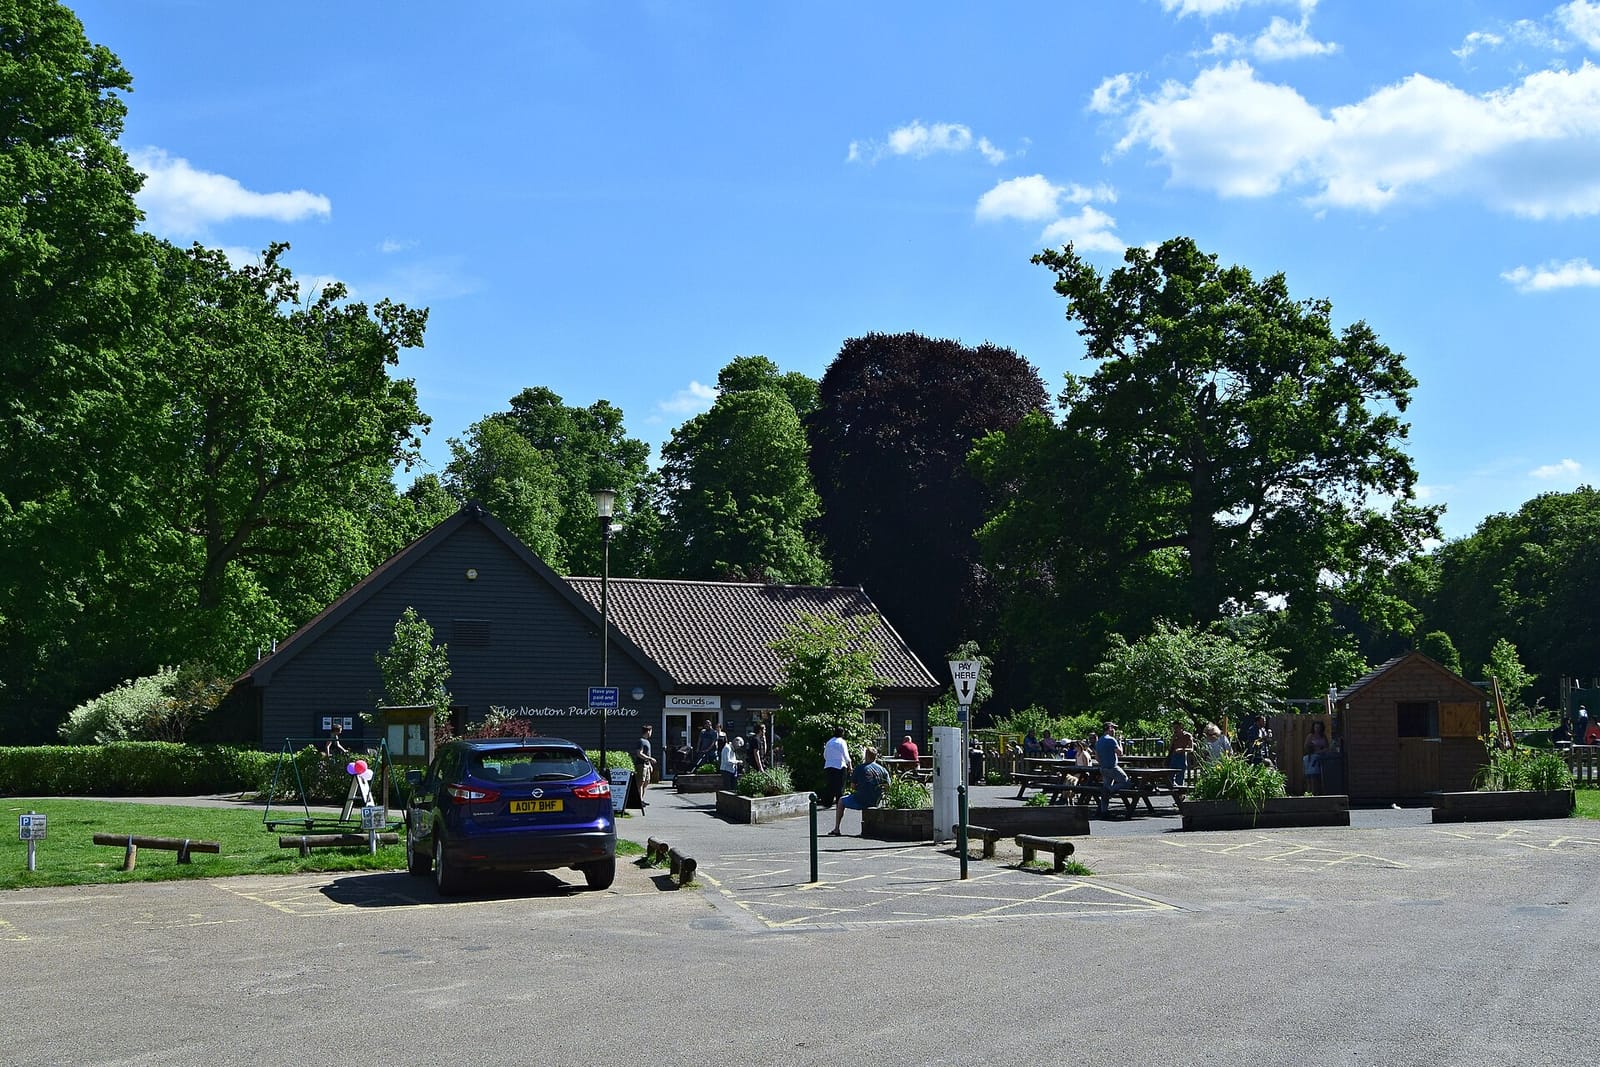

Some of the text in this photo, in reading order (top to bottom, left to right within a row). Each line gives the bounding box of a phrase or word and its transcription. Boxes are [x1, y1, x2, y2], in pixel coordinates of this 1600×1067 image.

[958, 662, 972, 670] PAY
[954, 672, 976, 680] HERE
[671, 696, 706, 705] Grounds
[495, 706, 639, 717] The Newton Park entre
[515, 800, 557, 812] AO17 BHF
[23, 817, 30, 827] P
